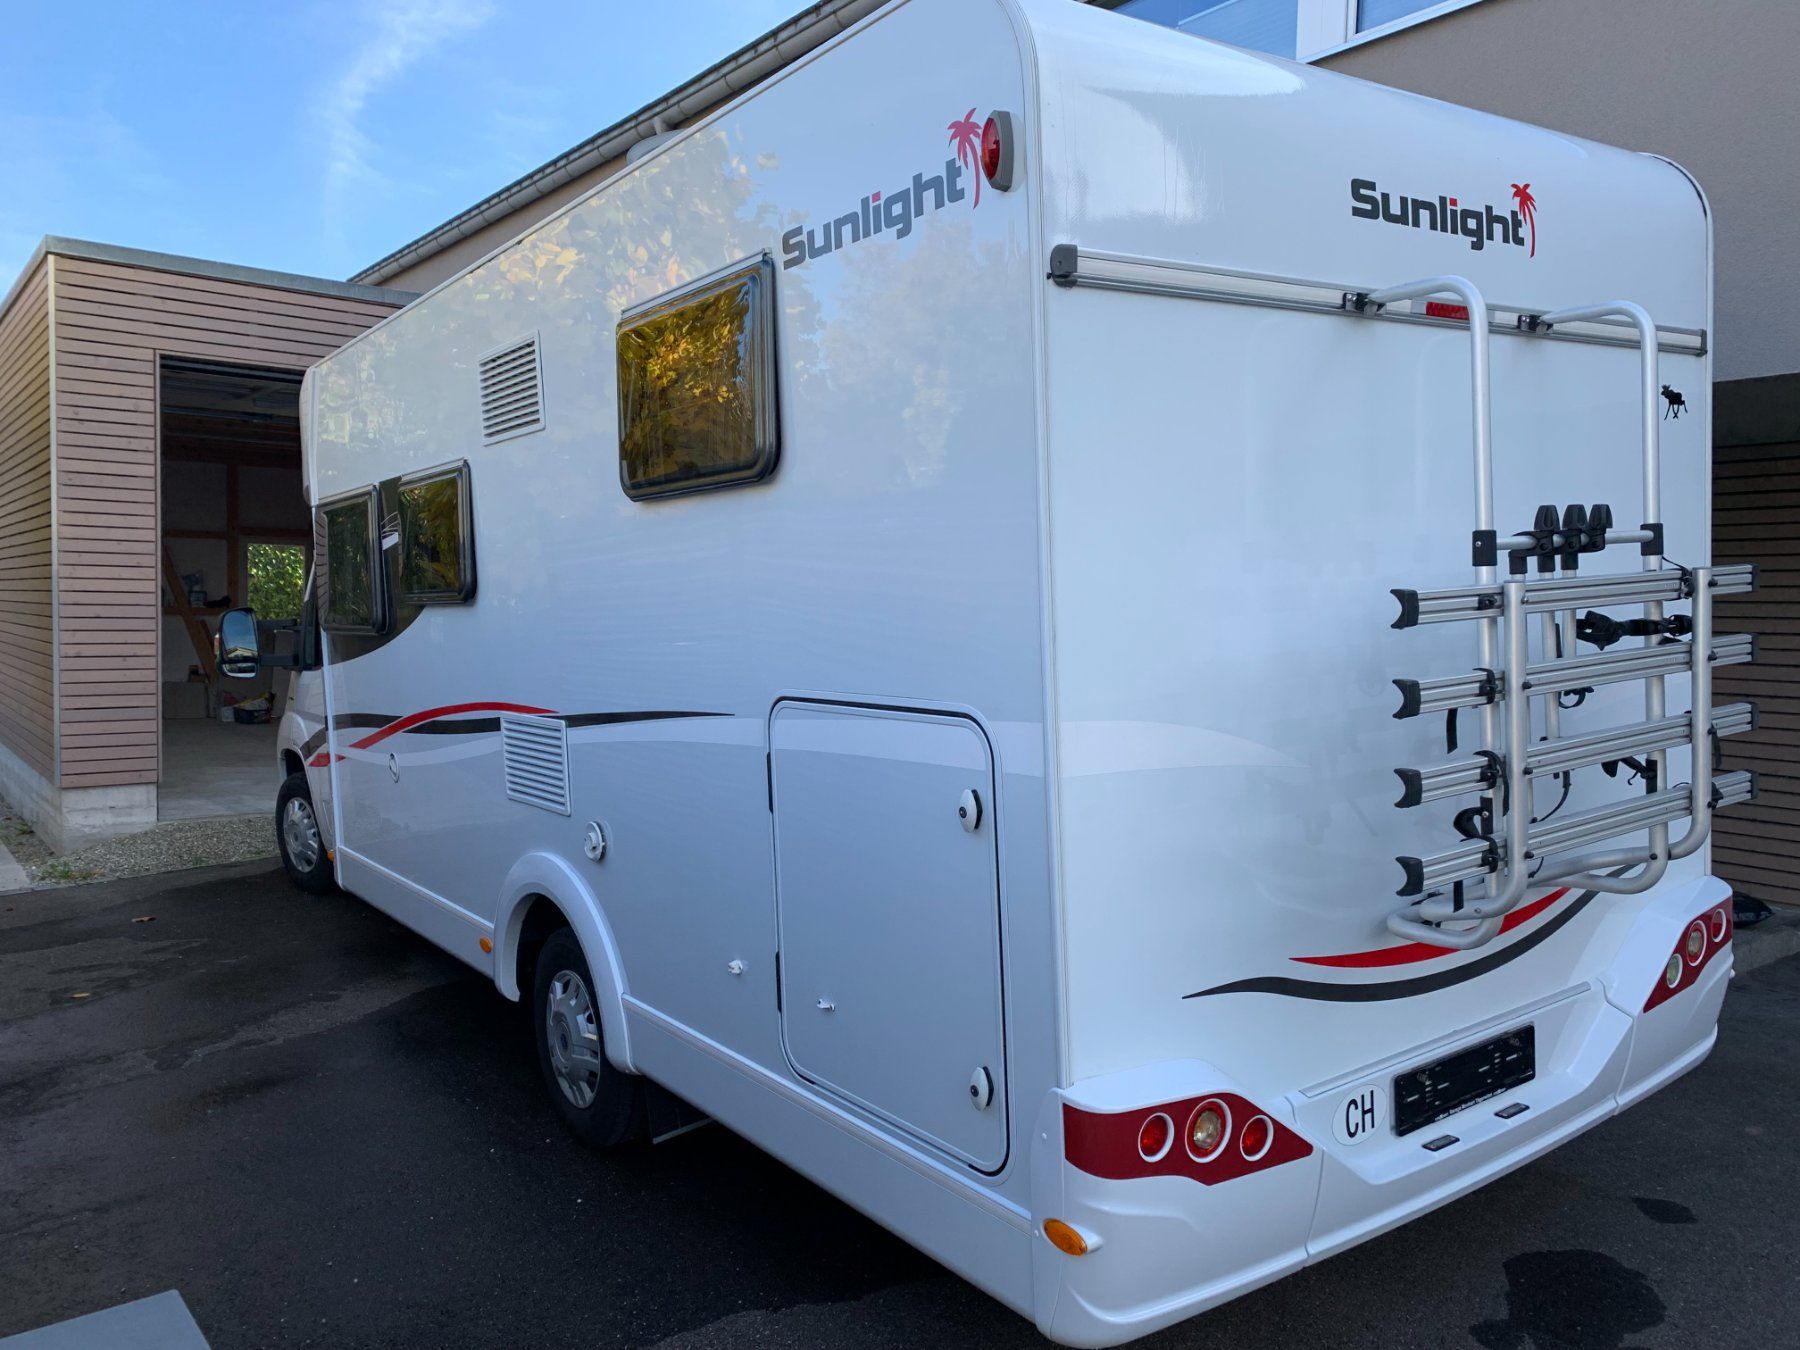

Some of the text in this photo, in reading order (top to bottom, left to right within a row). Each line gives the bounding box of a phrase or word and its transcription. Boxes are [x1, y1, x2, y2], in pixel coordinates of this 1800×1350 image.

[782, 157, 965, 270] Sunlight
[1351, 178, 1525, 251] Sunlight
[1345, 1089, 1375, 1138] CH
